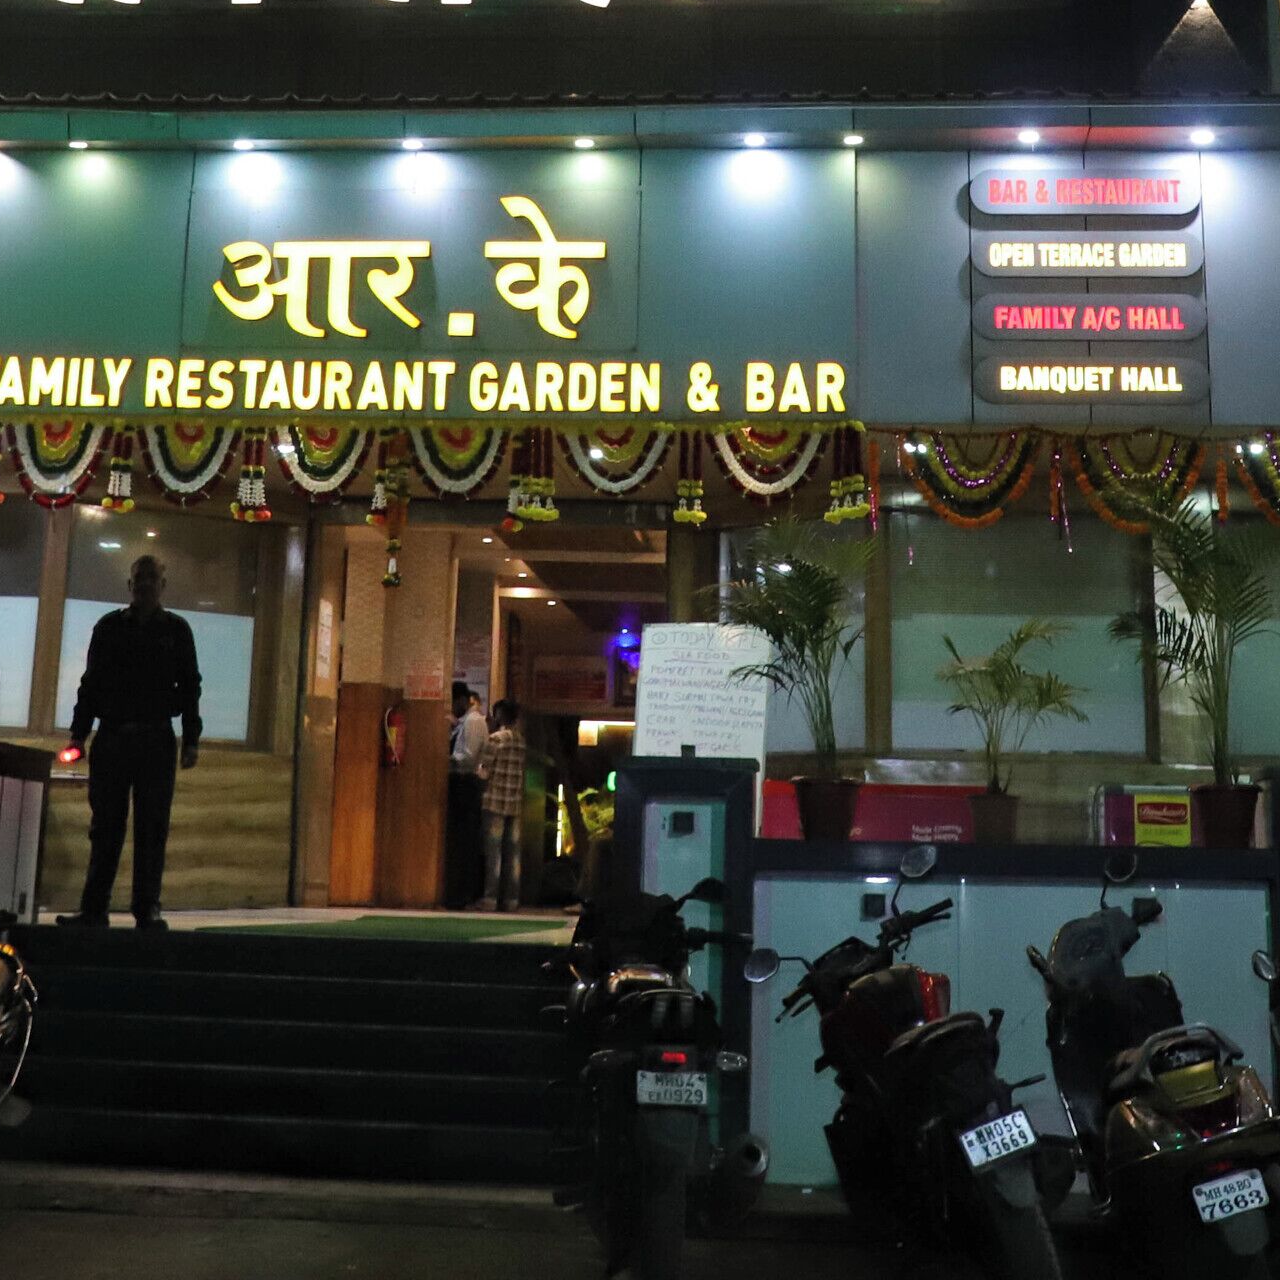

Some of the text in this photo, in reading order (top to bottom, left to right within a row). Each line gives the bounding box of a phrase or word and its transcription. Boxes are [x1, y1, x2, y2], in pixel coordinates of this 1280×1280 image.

[988, 178, 1181, 205] BAR & RESTAURANT
[989, 242, 1187, 268] OPEN TERRACE GARDEN
[994, 305, 1185, 332] FAMILY A/C HALL
[145, 359, 456, 413] RESTAURANT
[469, 361, 662, 414] GARDEN
[686, 362, 721, 414] &
[746, 362, 846, 414] BAR
[999, 365, 1183, 394] BANQUET HALL
[975, 1114, 1021, 1145] MH05C
[982, 1130, 1029, 1157] X3669
[1201, 1190, 1264, 1219] 7663
